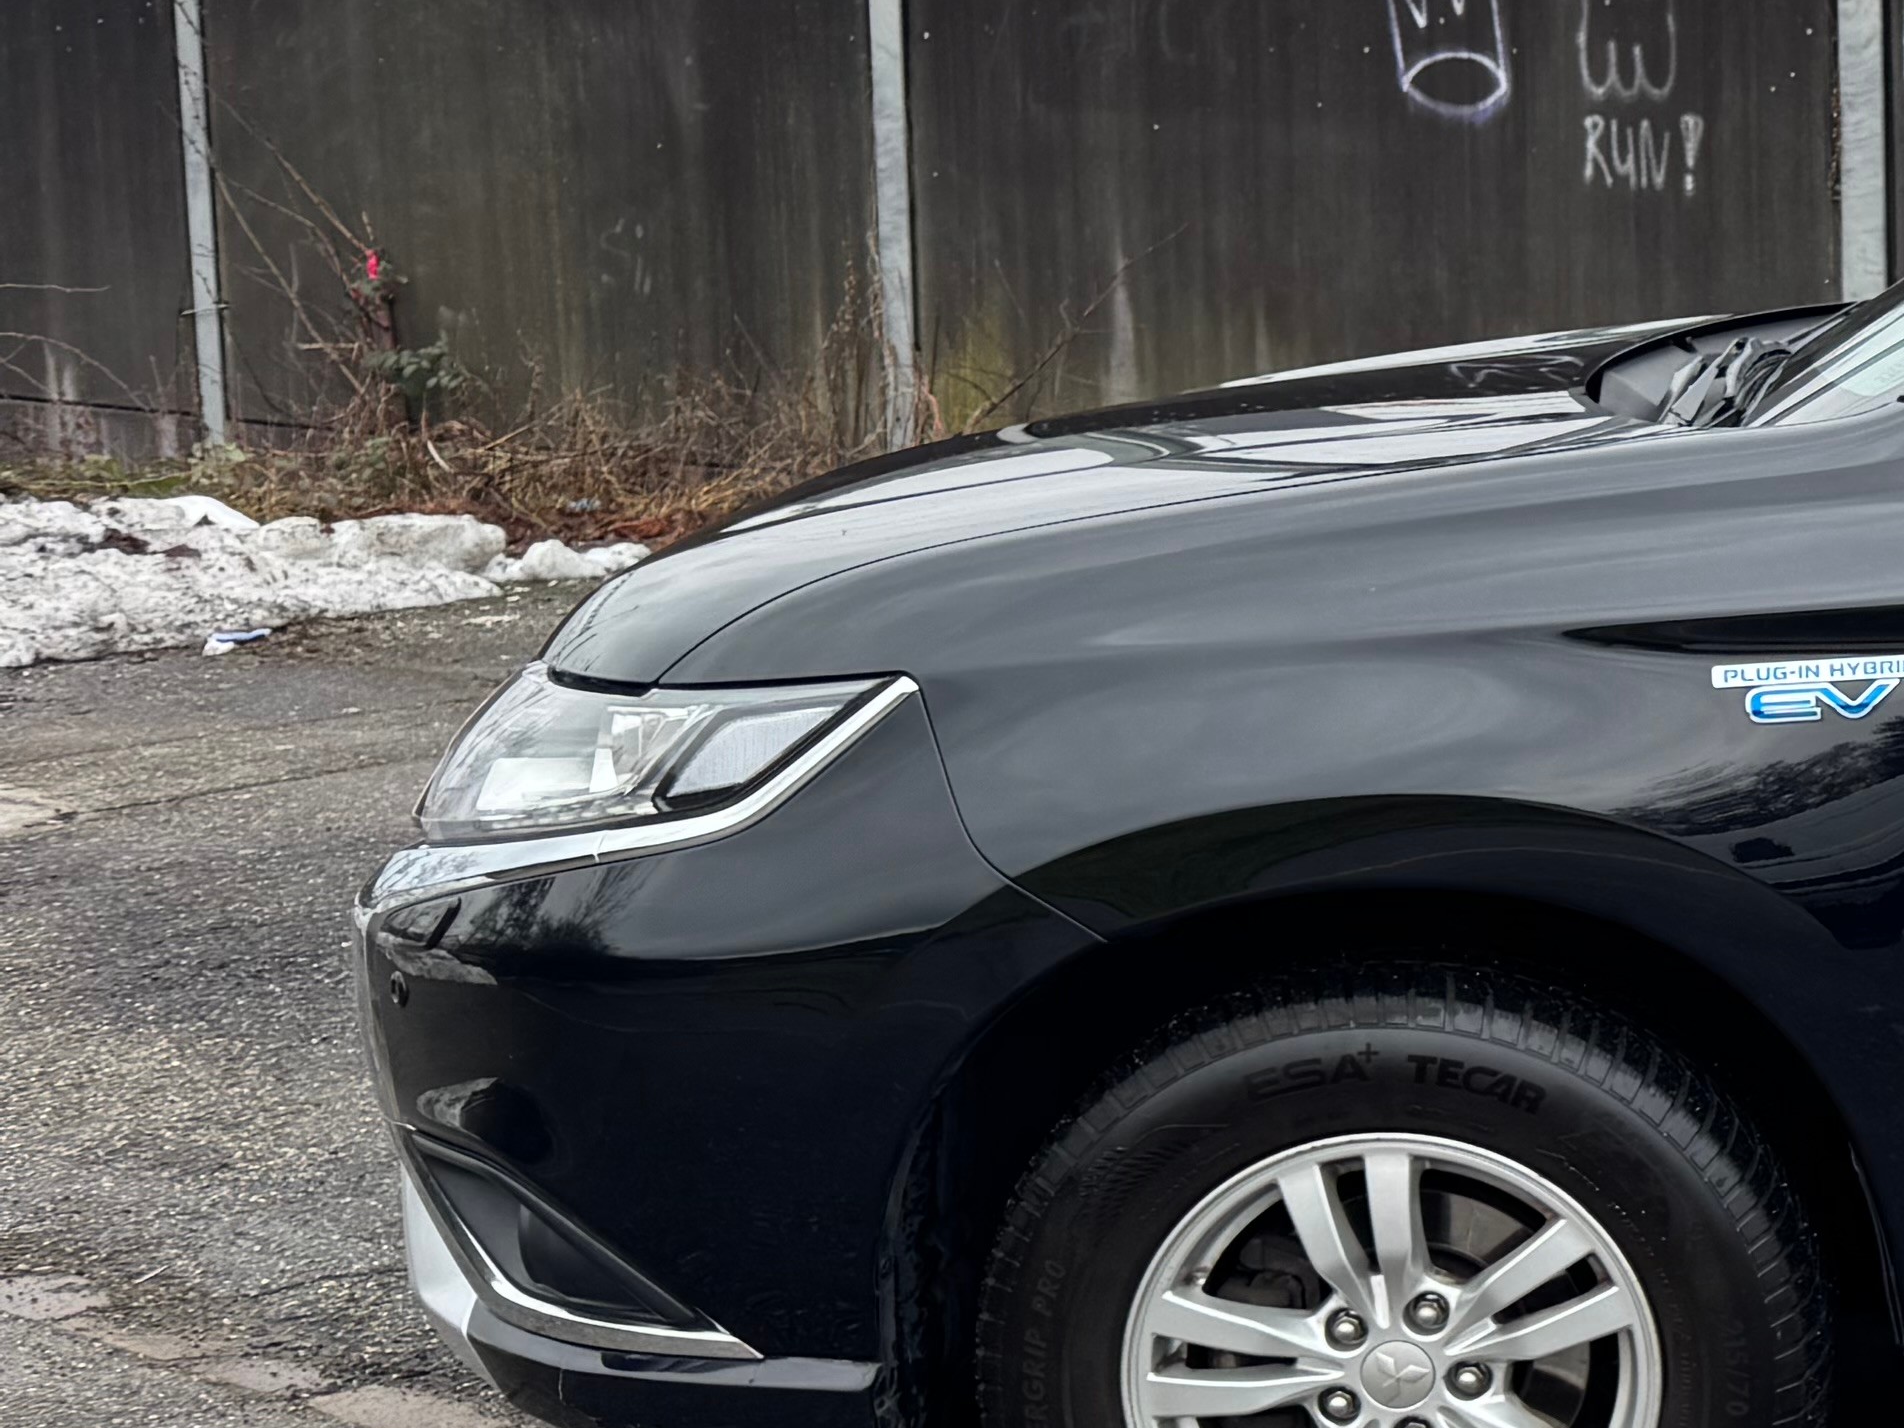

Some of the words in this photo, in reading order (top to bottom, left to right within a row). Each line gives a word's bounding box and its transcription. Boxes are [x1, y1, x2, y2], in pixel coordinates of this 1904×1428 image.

[1723, 664, 1820, 683] PLUG-IN
[1745, 678, 1901, 723] EV
[1407, 1053, 1546, 1114] TECAR
[1031, 1258, 1066, 1317] PRO
